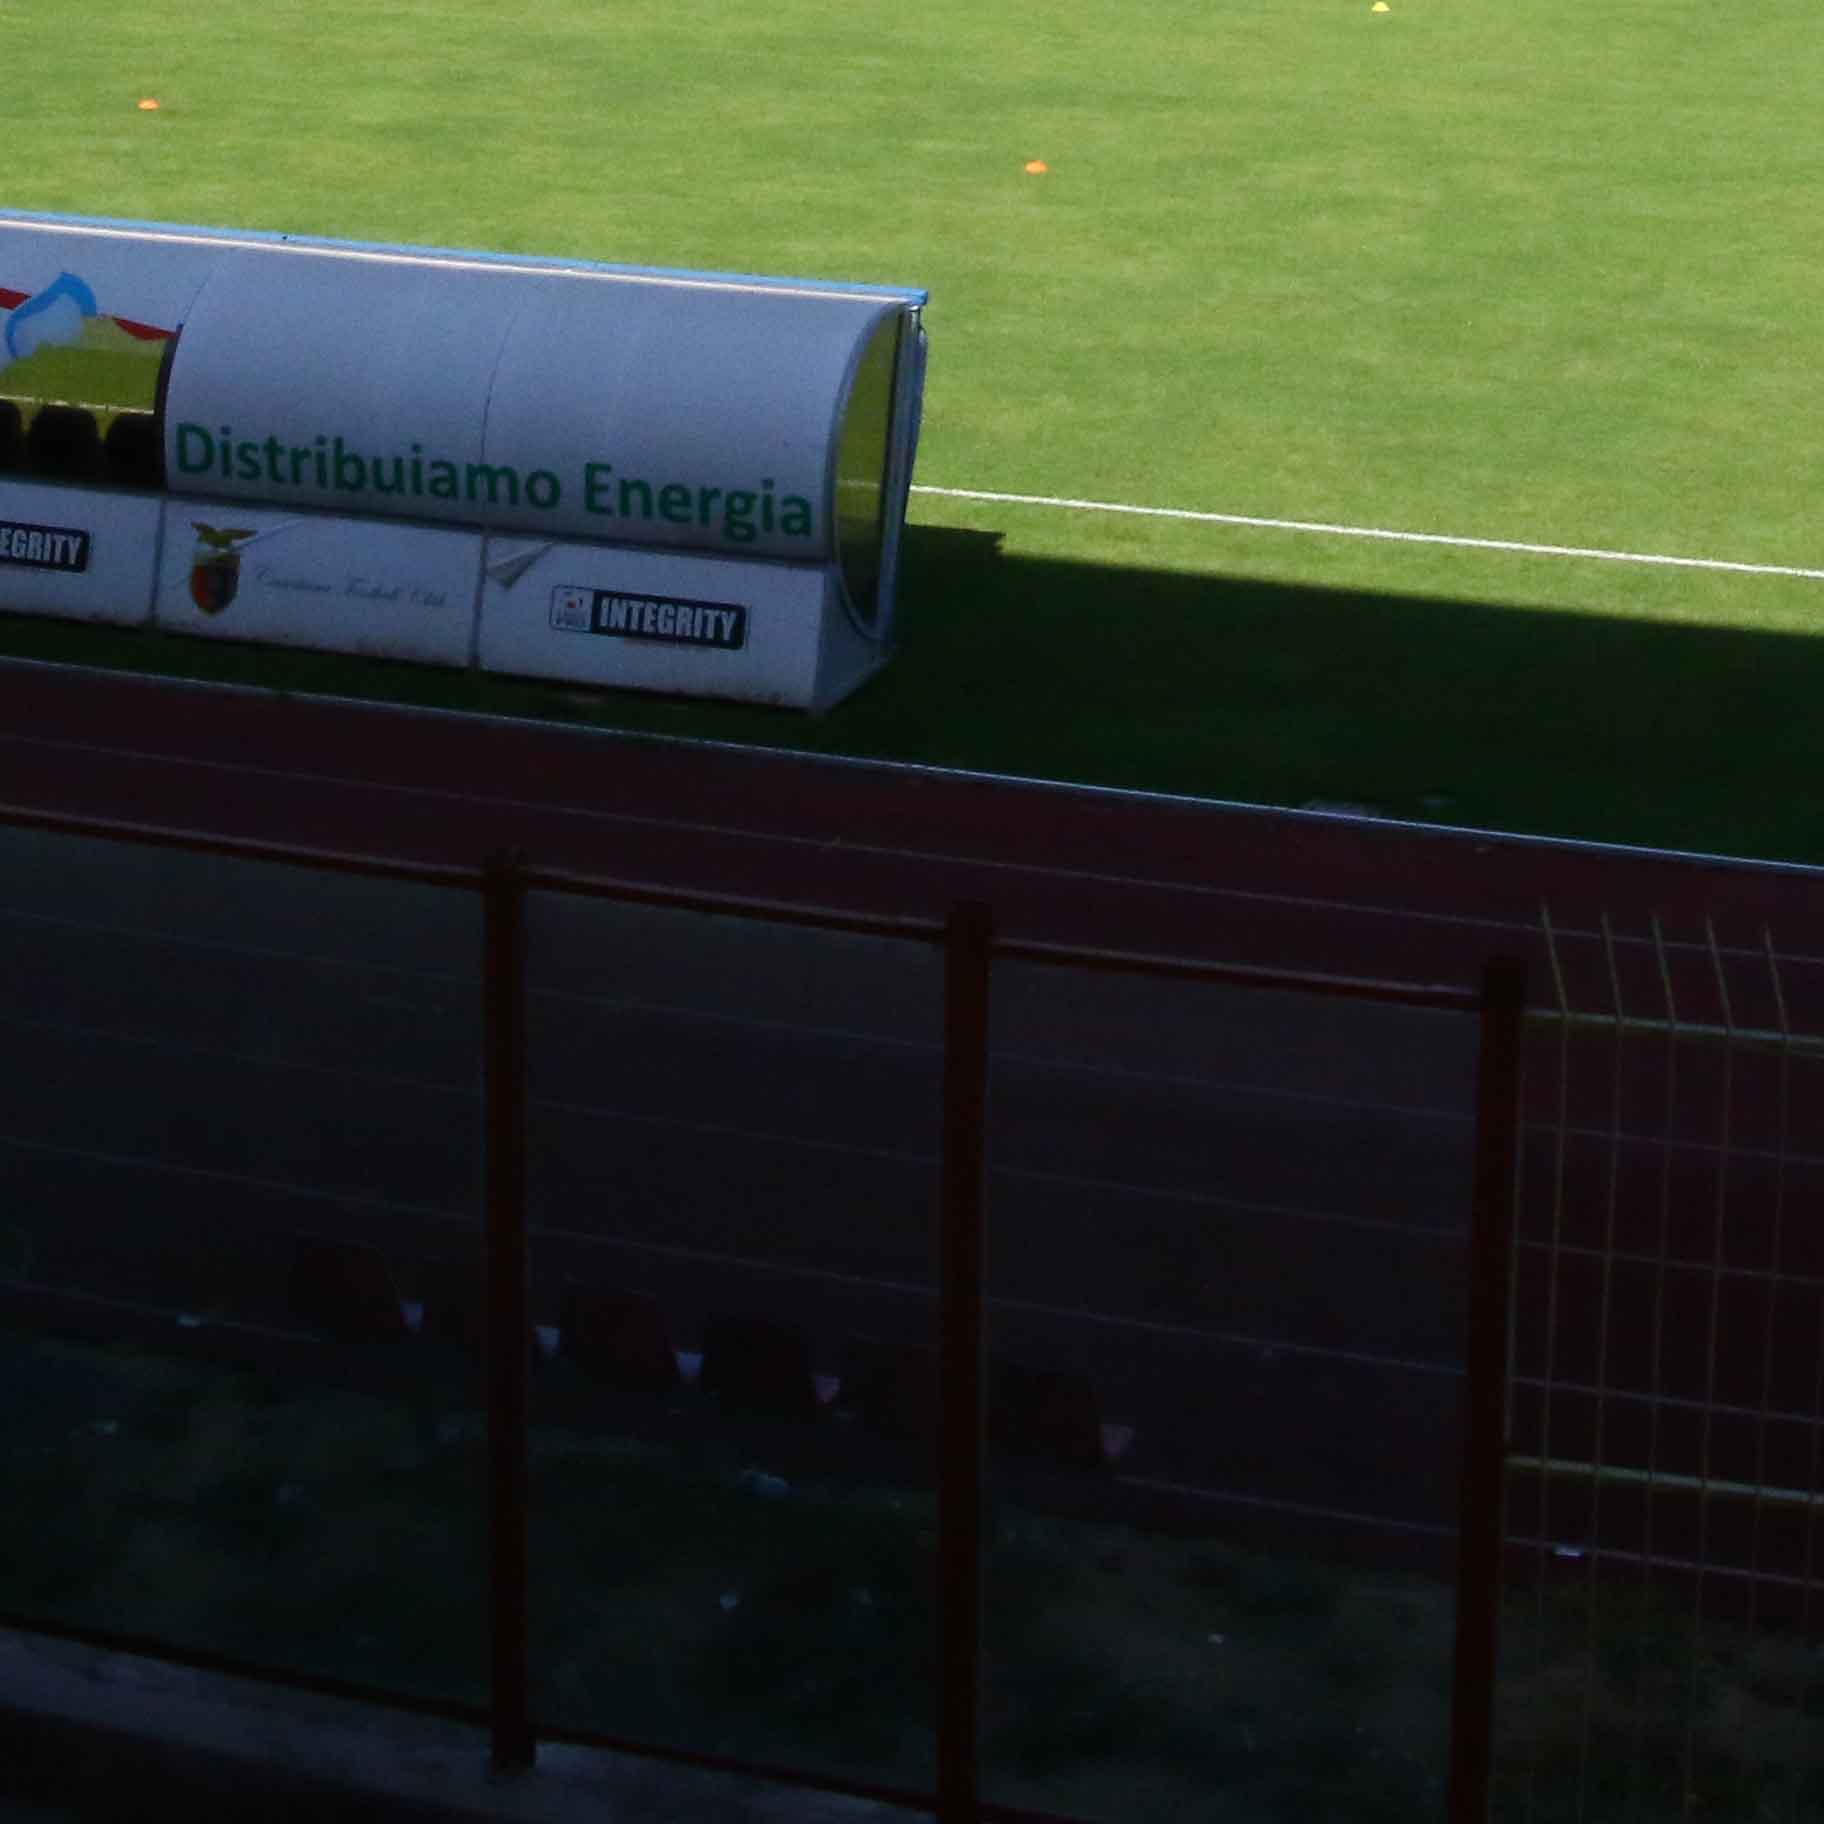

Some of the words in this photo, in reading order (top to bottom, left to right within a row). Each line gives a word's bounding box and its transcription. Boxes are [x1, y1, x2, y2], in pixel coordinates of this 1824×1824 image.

[176, 422, 561, 511] Distribuiamo
[583, 462, 814, 543] Energia
[600, 596, 737, 641] INTEGRITY
